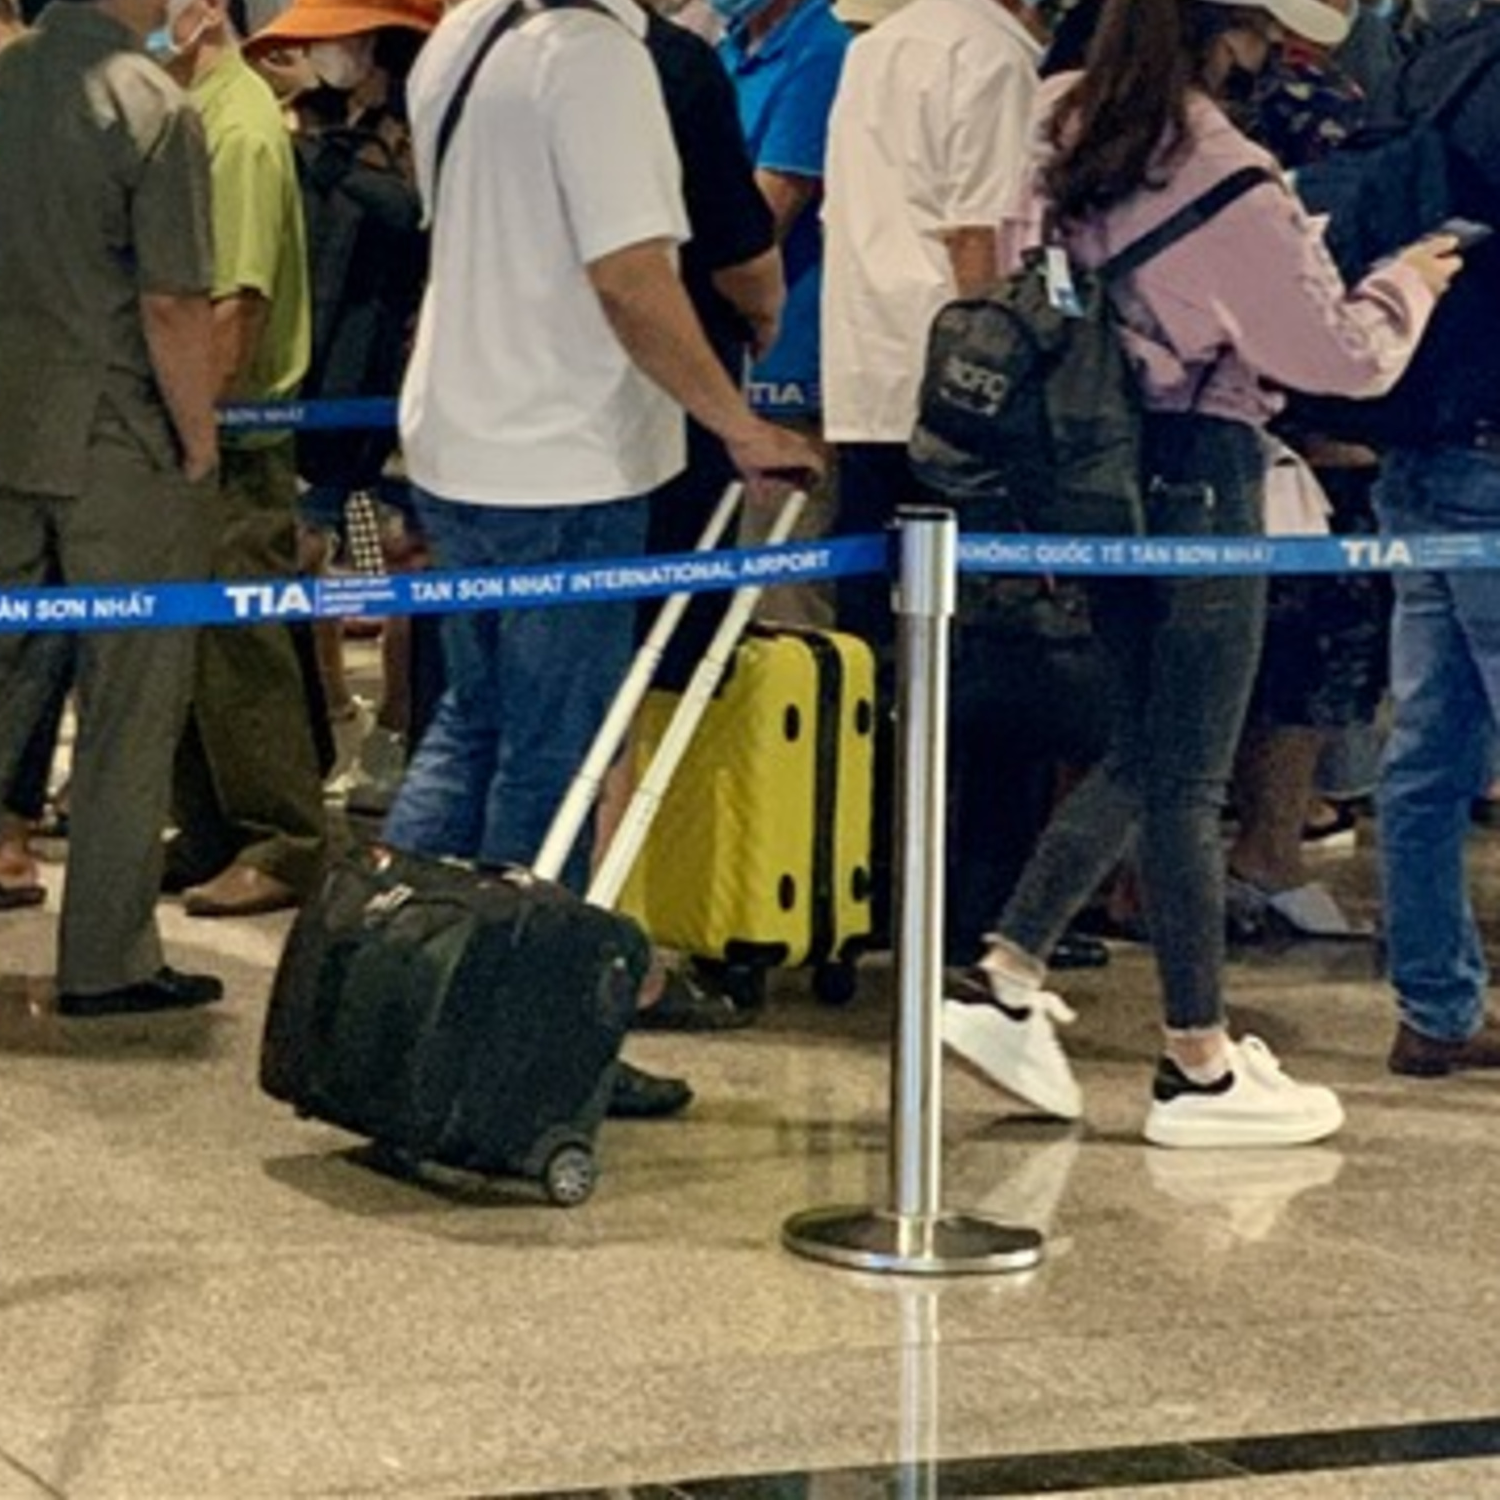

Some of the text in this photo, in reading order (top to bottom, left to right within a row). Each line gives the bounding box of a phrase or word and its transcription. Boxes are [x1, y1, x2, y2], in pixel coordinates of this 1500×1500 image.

[746, 382, 805, 405] TIA
[1035, 536, 1094, 564] QUỐC
[1340, 538, 1413, 568] TIA
[410, 581, 451, 602] TAN
[456, 578, 503, 600] SON
[508, 573, 566, 597] NHAT
[569, 559, 738, 593] INTERNATIONAL
[739, 549, 831, 577] AIRPORT
[34, 595, 87, 621] SƠN
[92, 588, 157, 618] NHẤT
[224, 582, 313, 618] TIA
